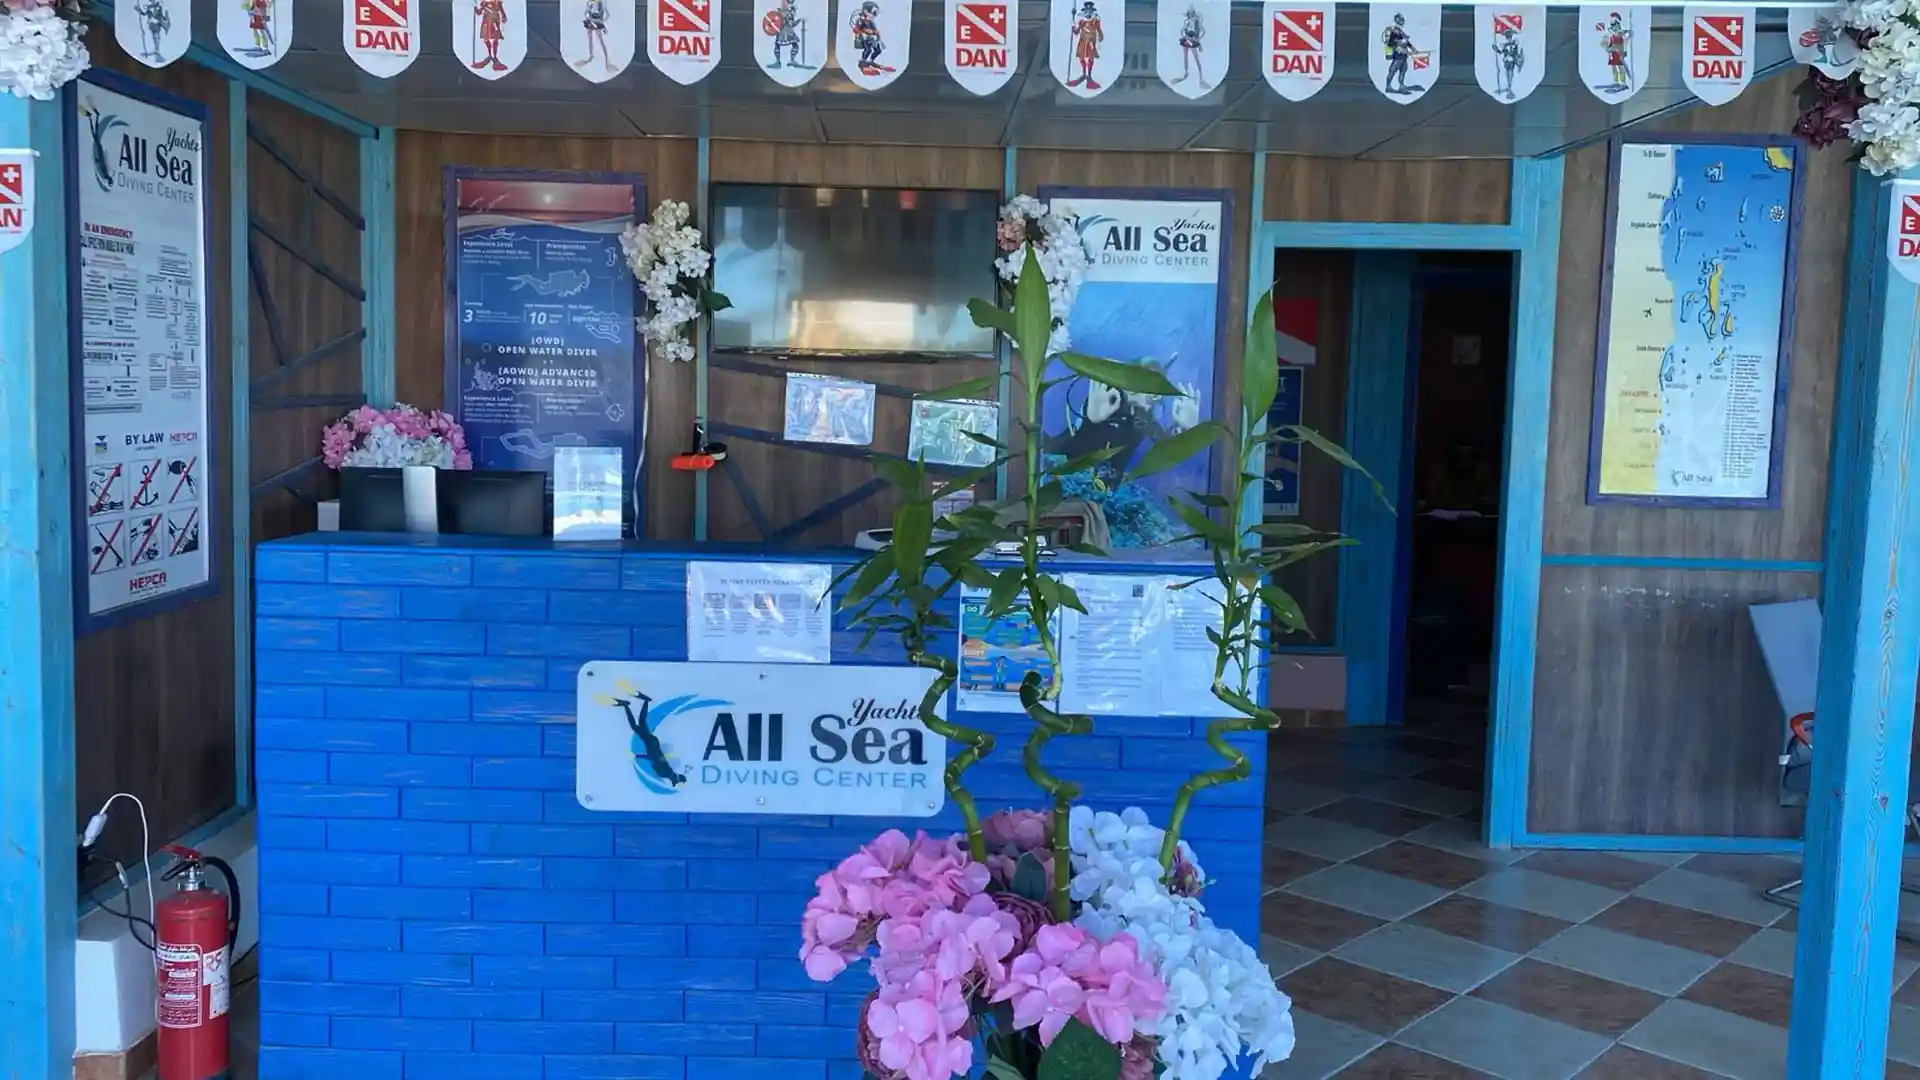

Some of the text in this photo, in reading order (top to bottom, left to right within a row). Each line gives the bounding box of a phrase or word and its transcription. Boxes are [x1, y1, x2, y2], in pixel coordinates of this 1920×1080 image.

[360, 7, 371, 21] E
[664, 13, 674, 27] E
[961, 25, 971, 39] E
[1278, 32, 1288, 46] E
[356, 30, 409, 51] DAN
[658, 36, 710, 56] DAN
[1698, 38, 1708, 51] E
[956, 48, 1006, 68] DAN
[1273, 55, 1322, 73] DAN
[1693, 60, 1742, 78] DAN
[119, 133, 193, 186] All Sea
[157, 182, 194, 204] CENTER
[1905, 216, 1916, 230] E
[1104, 226, 1208, 252] All Sea
[1155, 254, 1209, 266] CENTER
[464, 309, 473, 323] 3
[529, 312, 547, 325] 10
[531, 337, 564, 346] (OWD)
[498, 346, 598, 357] OPEN WATER DIVER
[499, 367, 597, 378] (AOWD) ADVANCED
[498, 377, 598, 388] OPEN WATER DIVER
[125, 431, 164, 446] BY LAW
[702, 712, 927, 765] All Sea
[702, 765, 927, 790] DIVING CENTER
